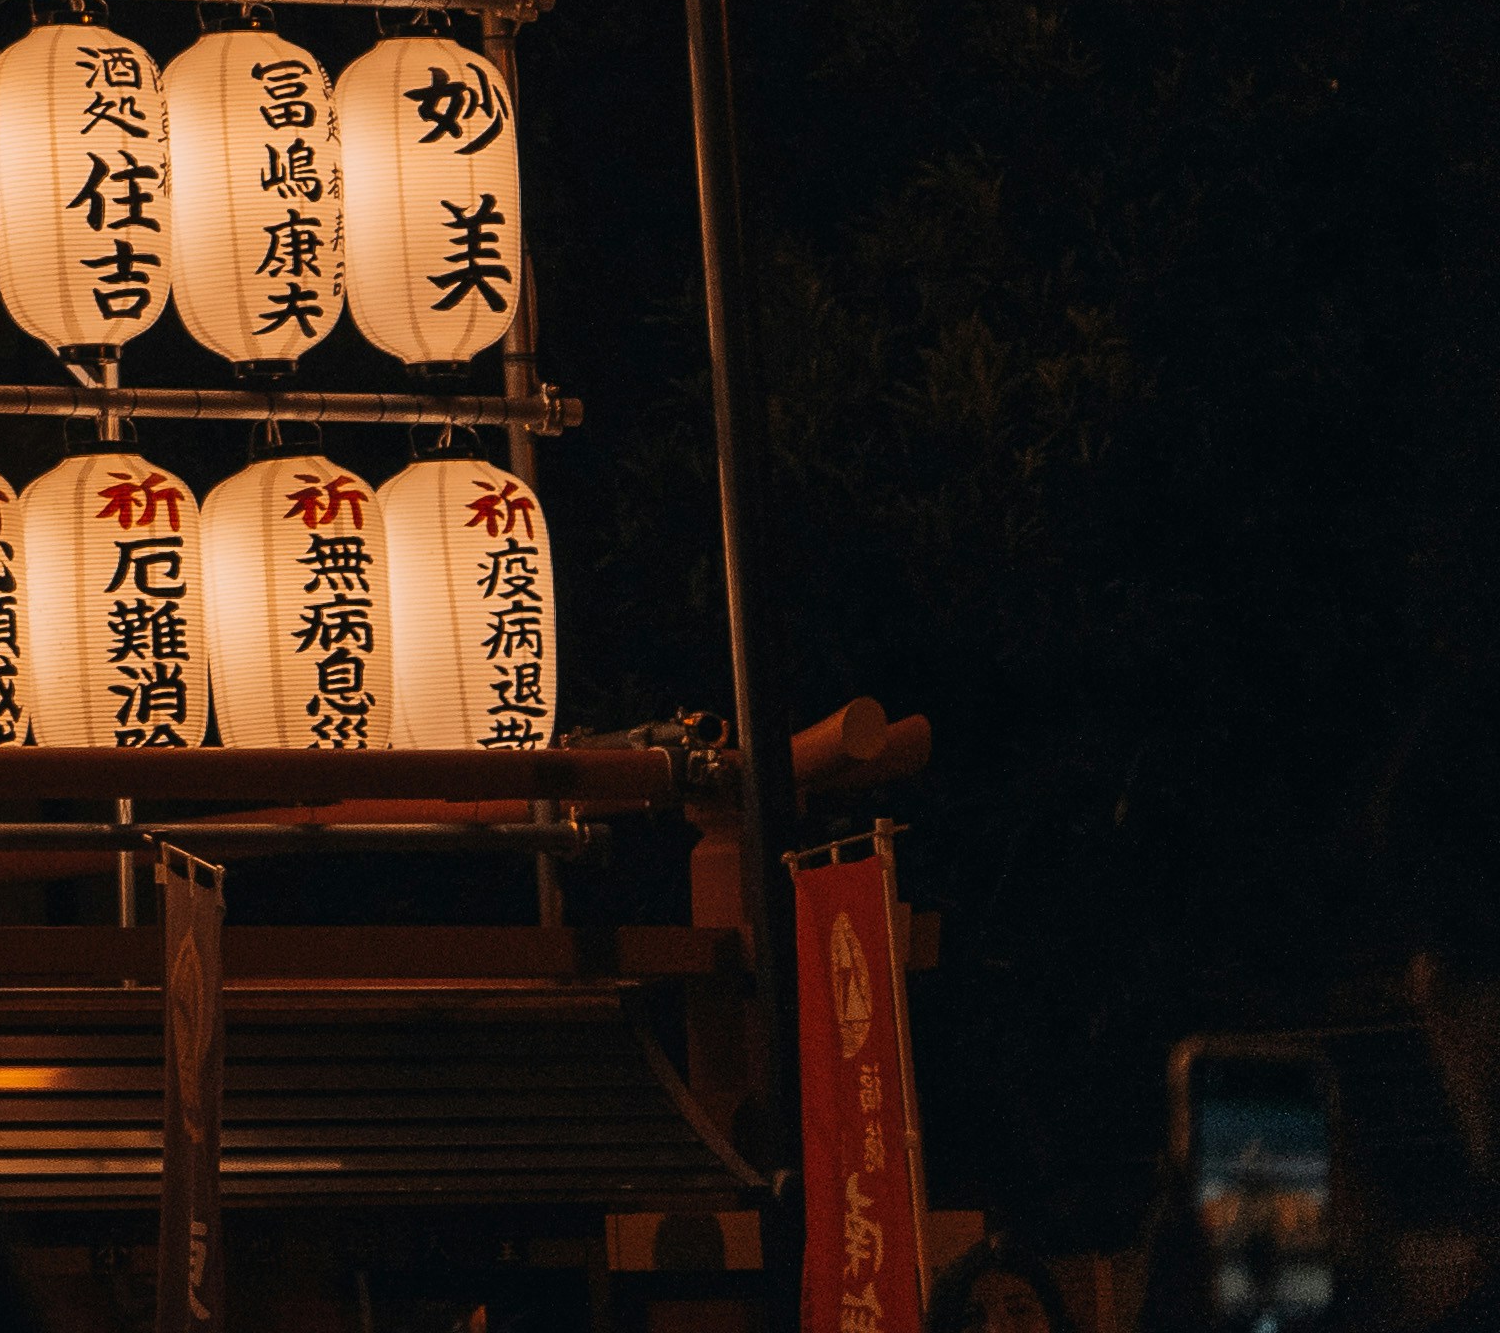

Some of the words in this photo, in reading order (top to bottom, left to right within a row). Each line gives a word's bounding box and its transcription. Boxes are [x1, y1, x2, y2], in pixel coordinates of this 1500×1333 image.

[65, 45, 163, 321] 酒処住吉
[403, 61, 513, 314] 妙美
